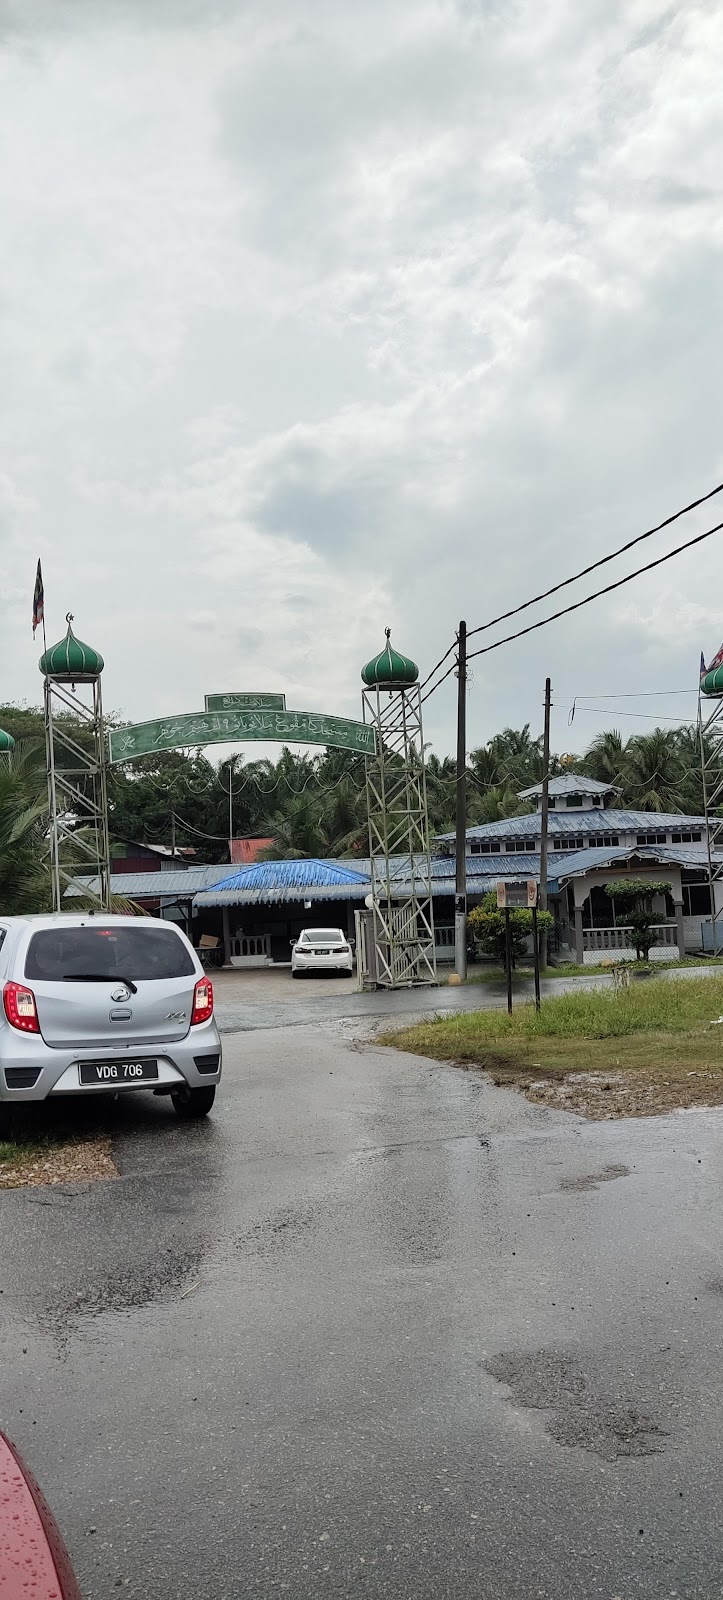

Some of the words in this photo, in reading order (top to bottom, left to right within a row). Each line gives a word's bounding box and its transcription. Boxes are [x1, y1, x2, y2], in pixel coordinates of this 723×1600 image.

[355, 729, 370, 745] الله
[96, 1066, 118, 1078] VDG
[122, 1064, 143, 1076] 706
